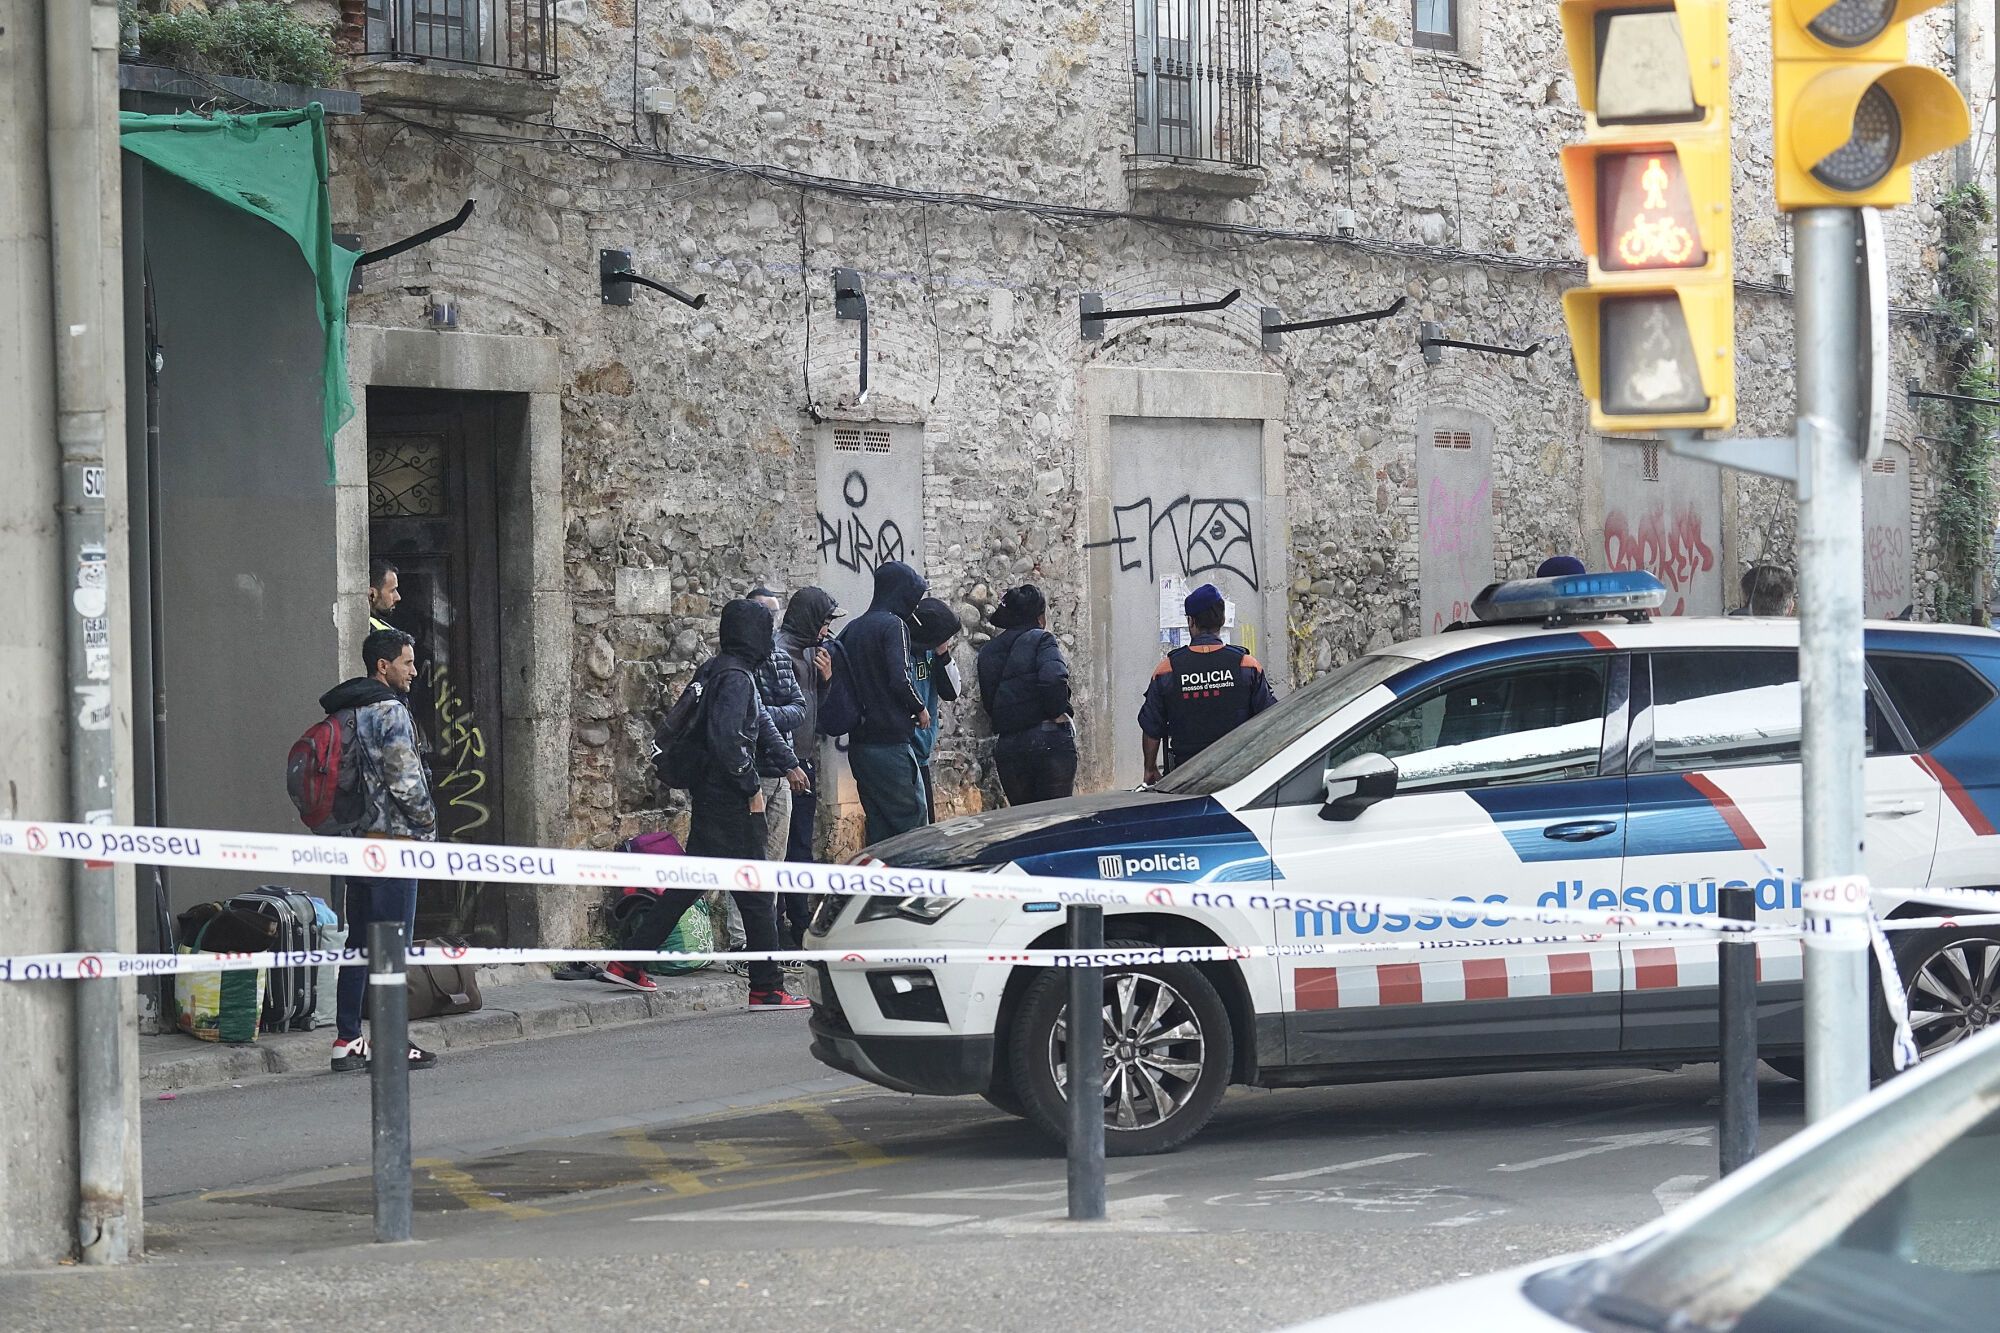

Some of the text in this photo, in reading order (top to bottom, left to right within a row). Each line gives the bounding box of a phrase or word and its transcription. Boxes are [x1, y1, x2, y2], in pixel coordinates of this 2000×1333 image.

[1181, 669, 1234, 686] POLICIA
[59, 830, 93, 850] no
[102, 833, 201, 856] passeu
[292, 846, 349, 866] policia
[400, 848, 435, 869] no
[447, 851, 556, 876] passeu
[1125, 852, 1201, 877] policia
[655, 866, 719, 885] policia
[776, 869, 815, 889] no
[828, 872, 948, 896] passeu
